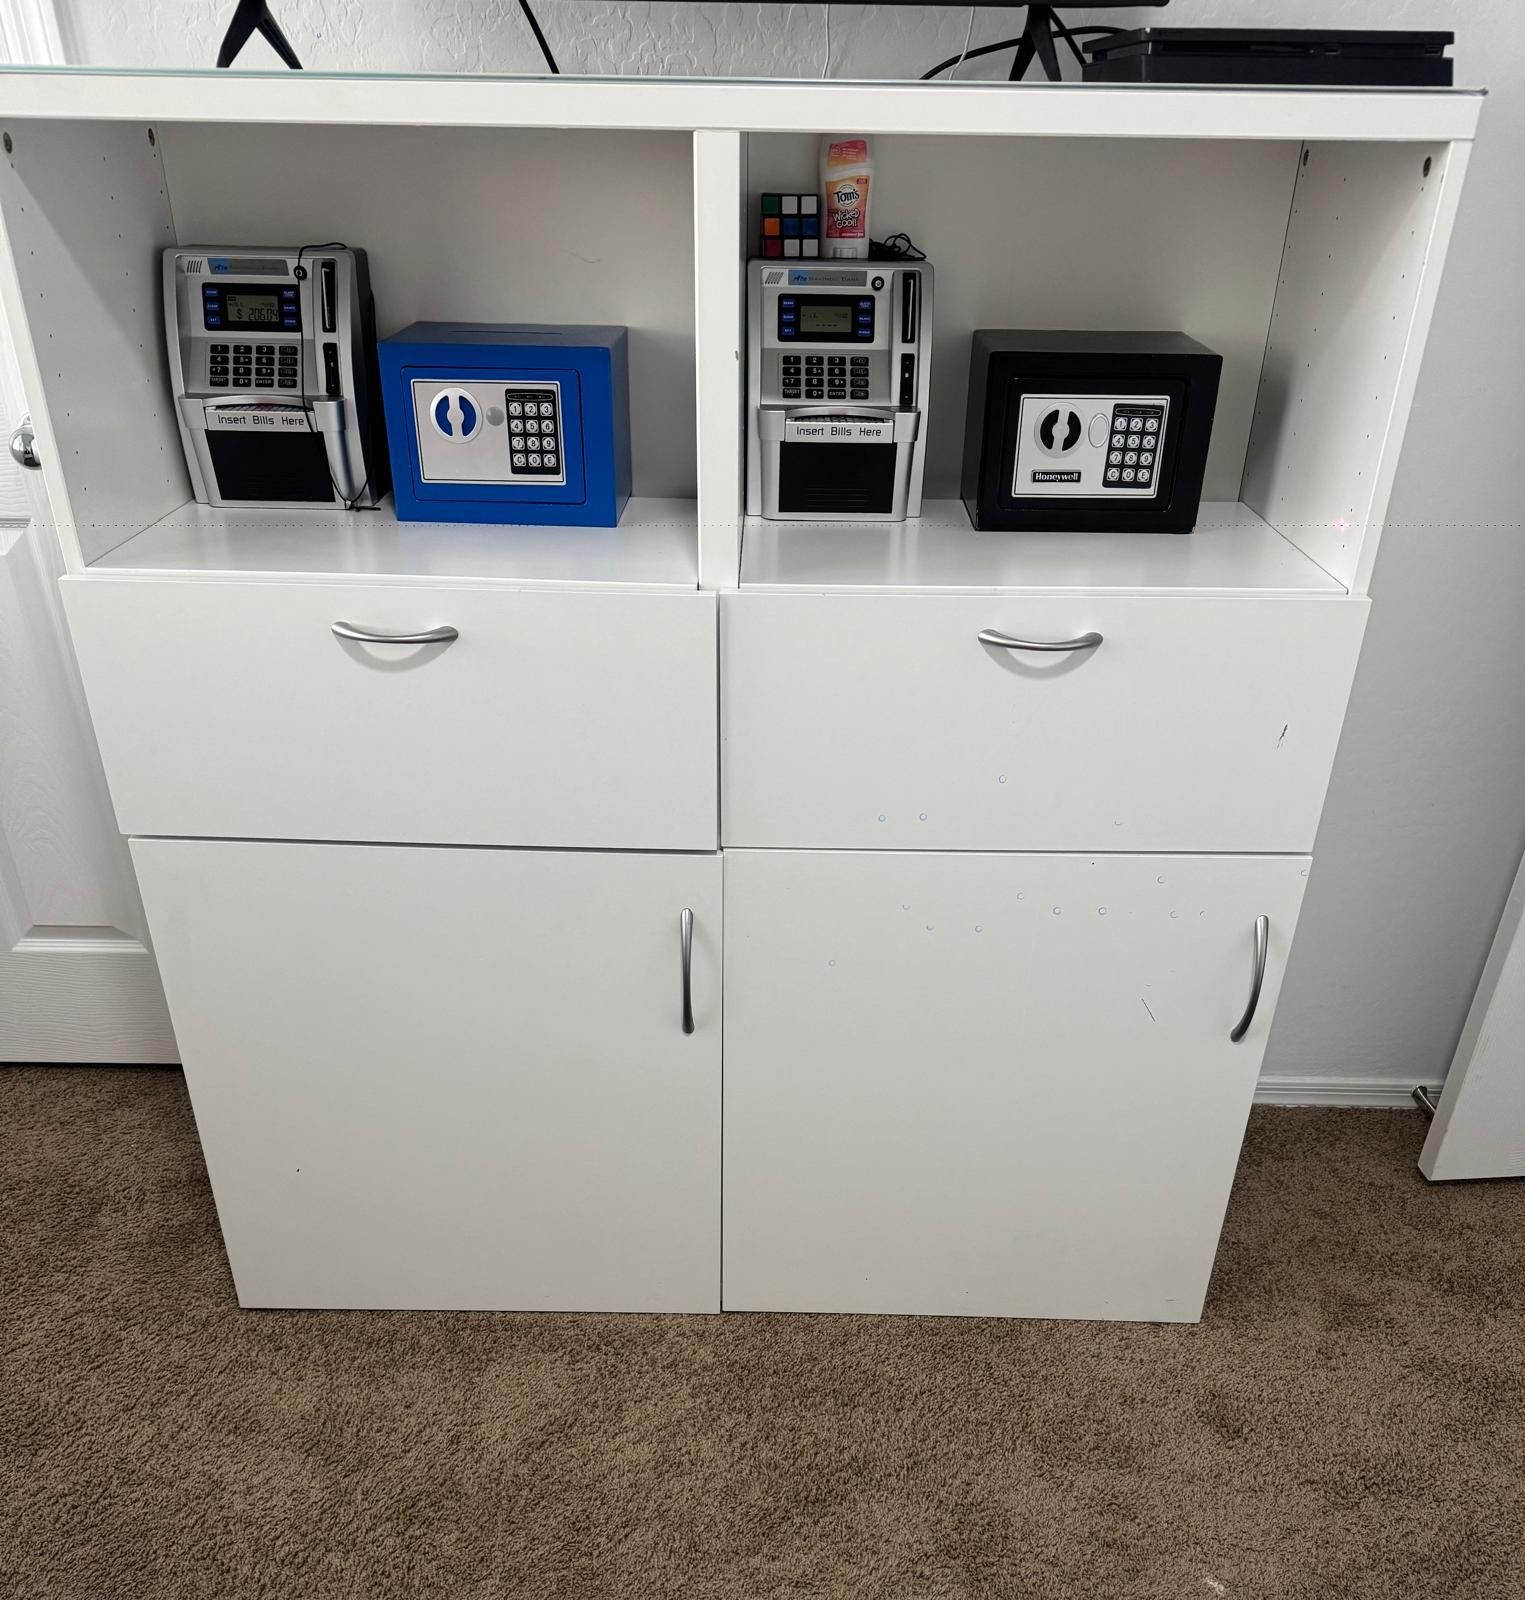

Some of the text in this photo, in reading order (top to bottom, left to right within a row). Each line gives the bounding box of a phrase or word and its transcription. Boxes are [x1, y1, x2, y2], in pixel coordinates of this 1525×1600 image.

[833, 188, 860, 203] Tom's
[217, 415, 305, 426] Insert Bills Here
[796, 426, 882, 437] Insert Bills Here
[1035, 472, 1079, 482] Honeywell
